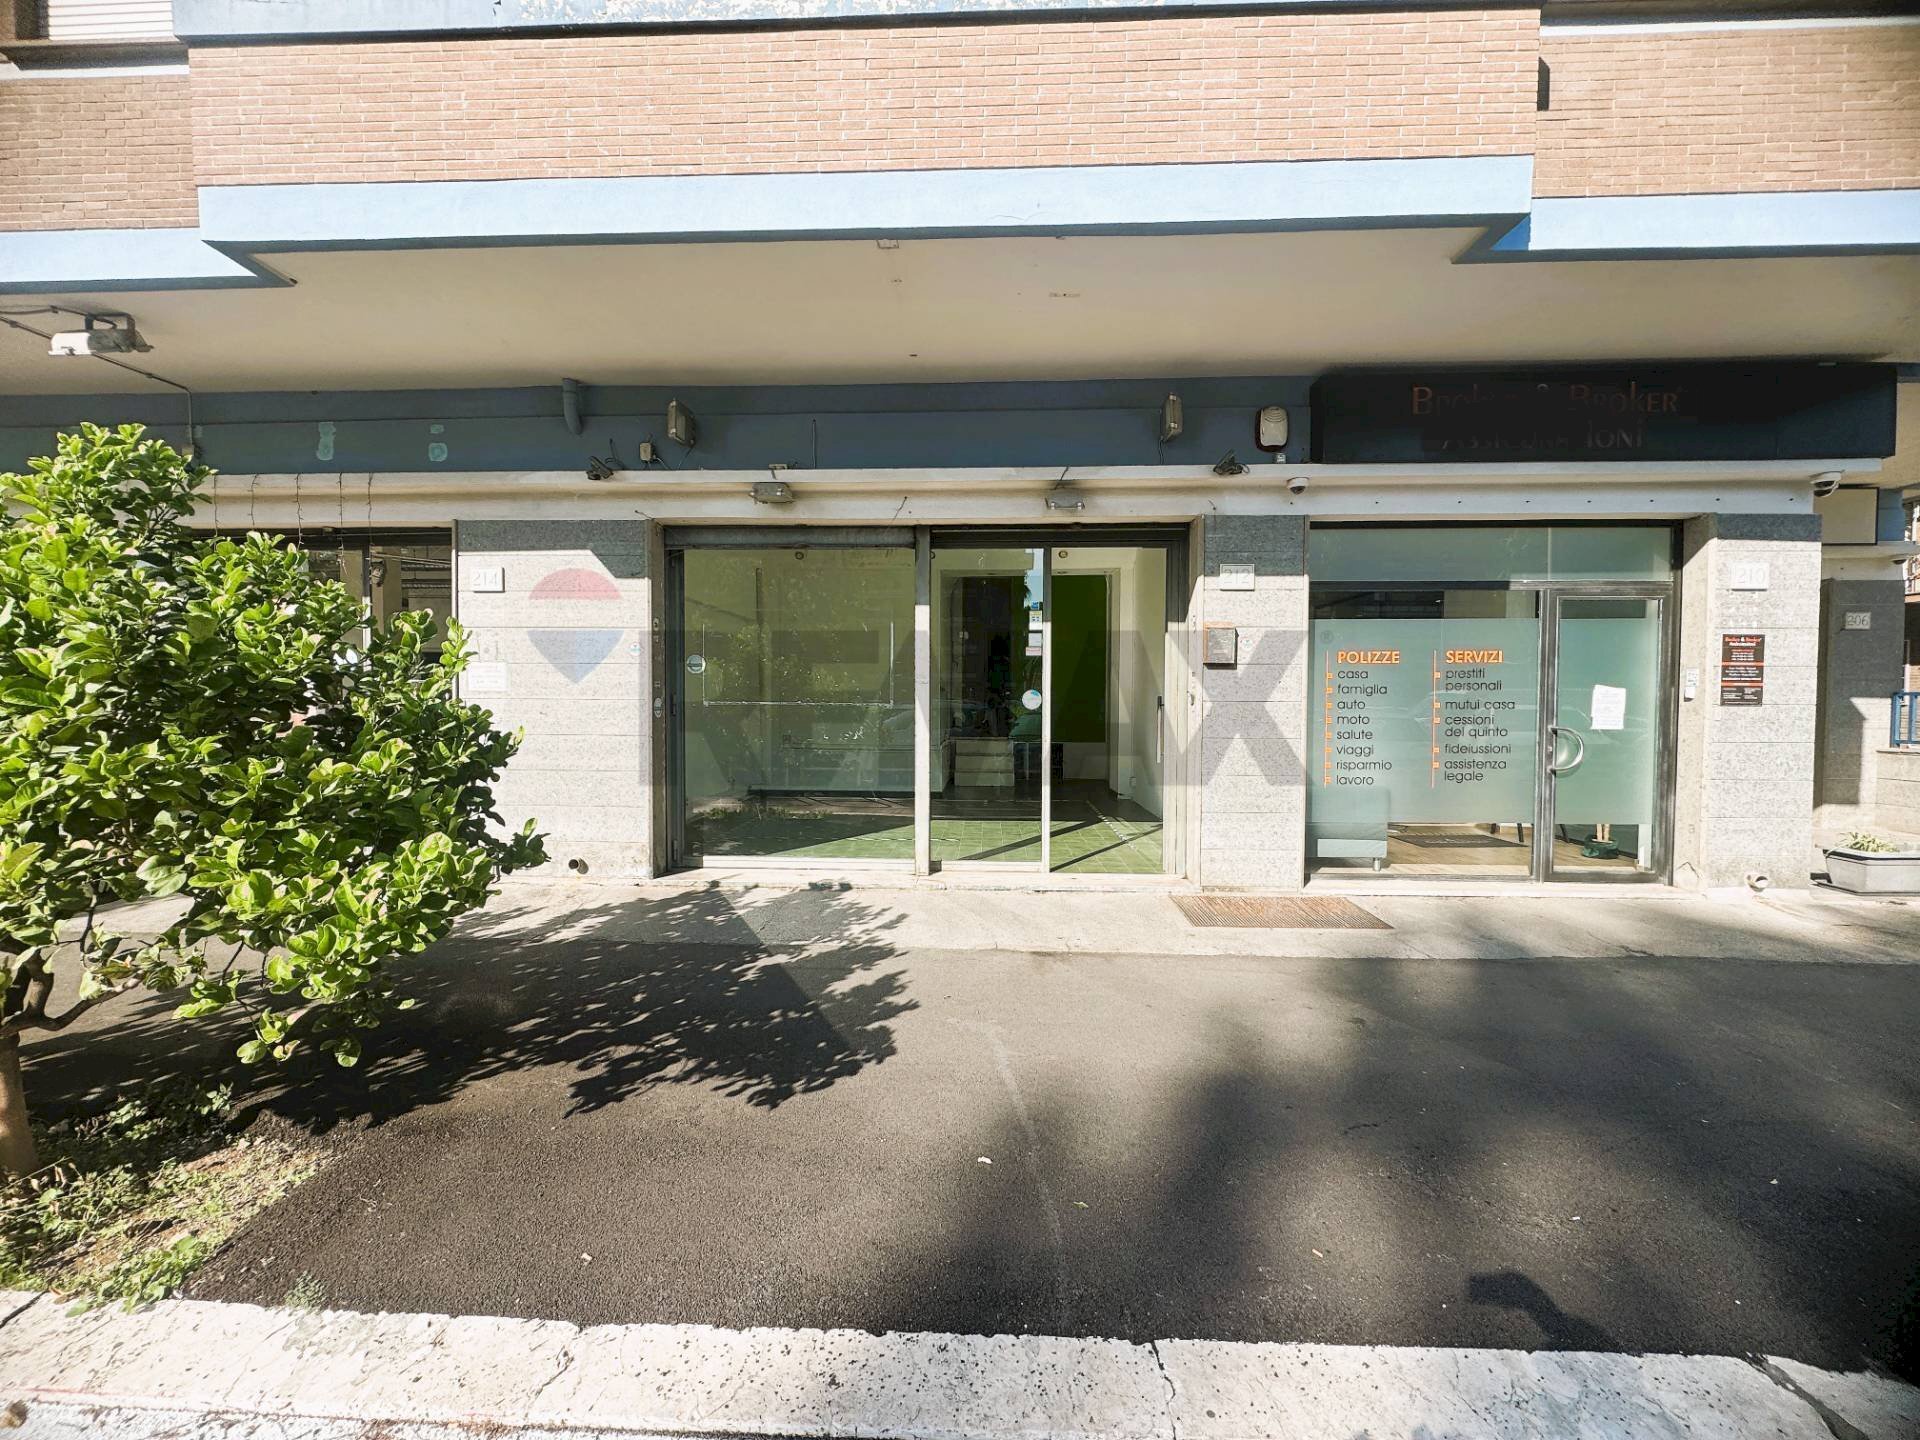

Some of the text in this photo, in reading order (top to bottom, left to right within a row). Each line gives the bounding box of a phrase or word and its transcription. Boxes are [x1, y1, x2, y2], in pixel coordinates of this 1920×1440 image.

[1847, 614, 1869, 626] 206
[1337, 650, 1400, 664] POLIZZE
[1445, 649, 1504, 664] SERVIZI
[1337, 670, 1369, 679] casa
[1445, 667, 1486, 680] prestiti
[1337, 683, 1388, 696] famiglia
[1445, 680, 1502, 693] personali
[1337, 700, 1366, 710] auto
[1445, 699, 1515, 710] mutui casa
[1336, 714, 1370, 725] moto
[1444, 714, 1495, 725] cessioni
[1336, 729, 1373, 740] salute
[1444, 726, 1508, 739] del quinto
[1336, 744, 1374, 757] viaggi
[1444, 743, 1512, 754] fideiussioni
[1336, 760, 1393, 772] risparmio
[1444, 758, 1507, 770] assistenza
[1336, 774, 1374, 786] lavoro
[1444, 770, 1484, 784] legale
